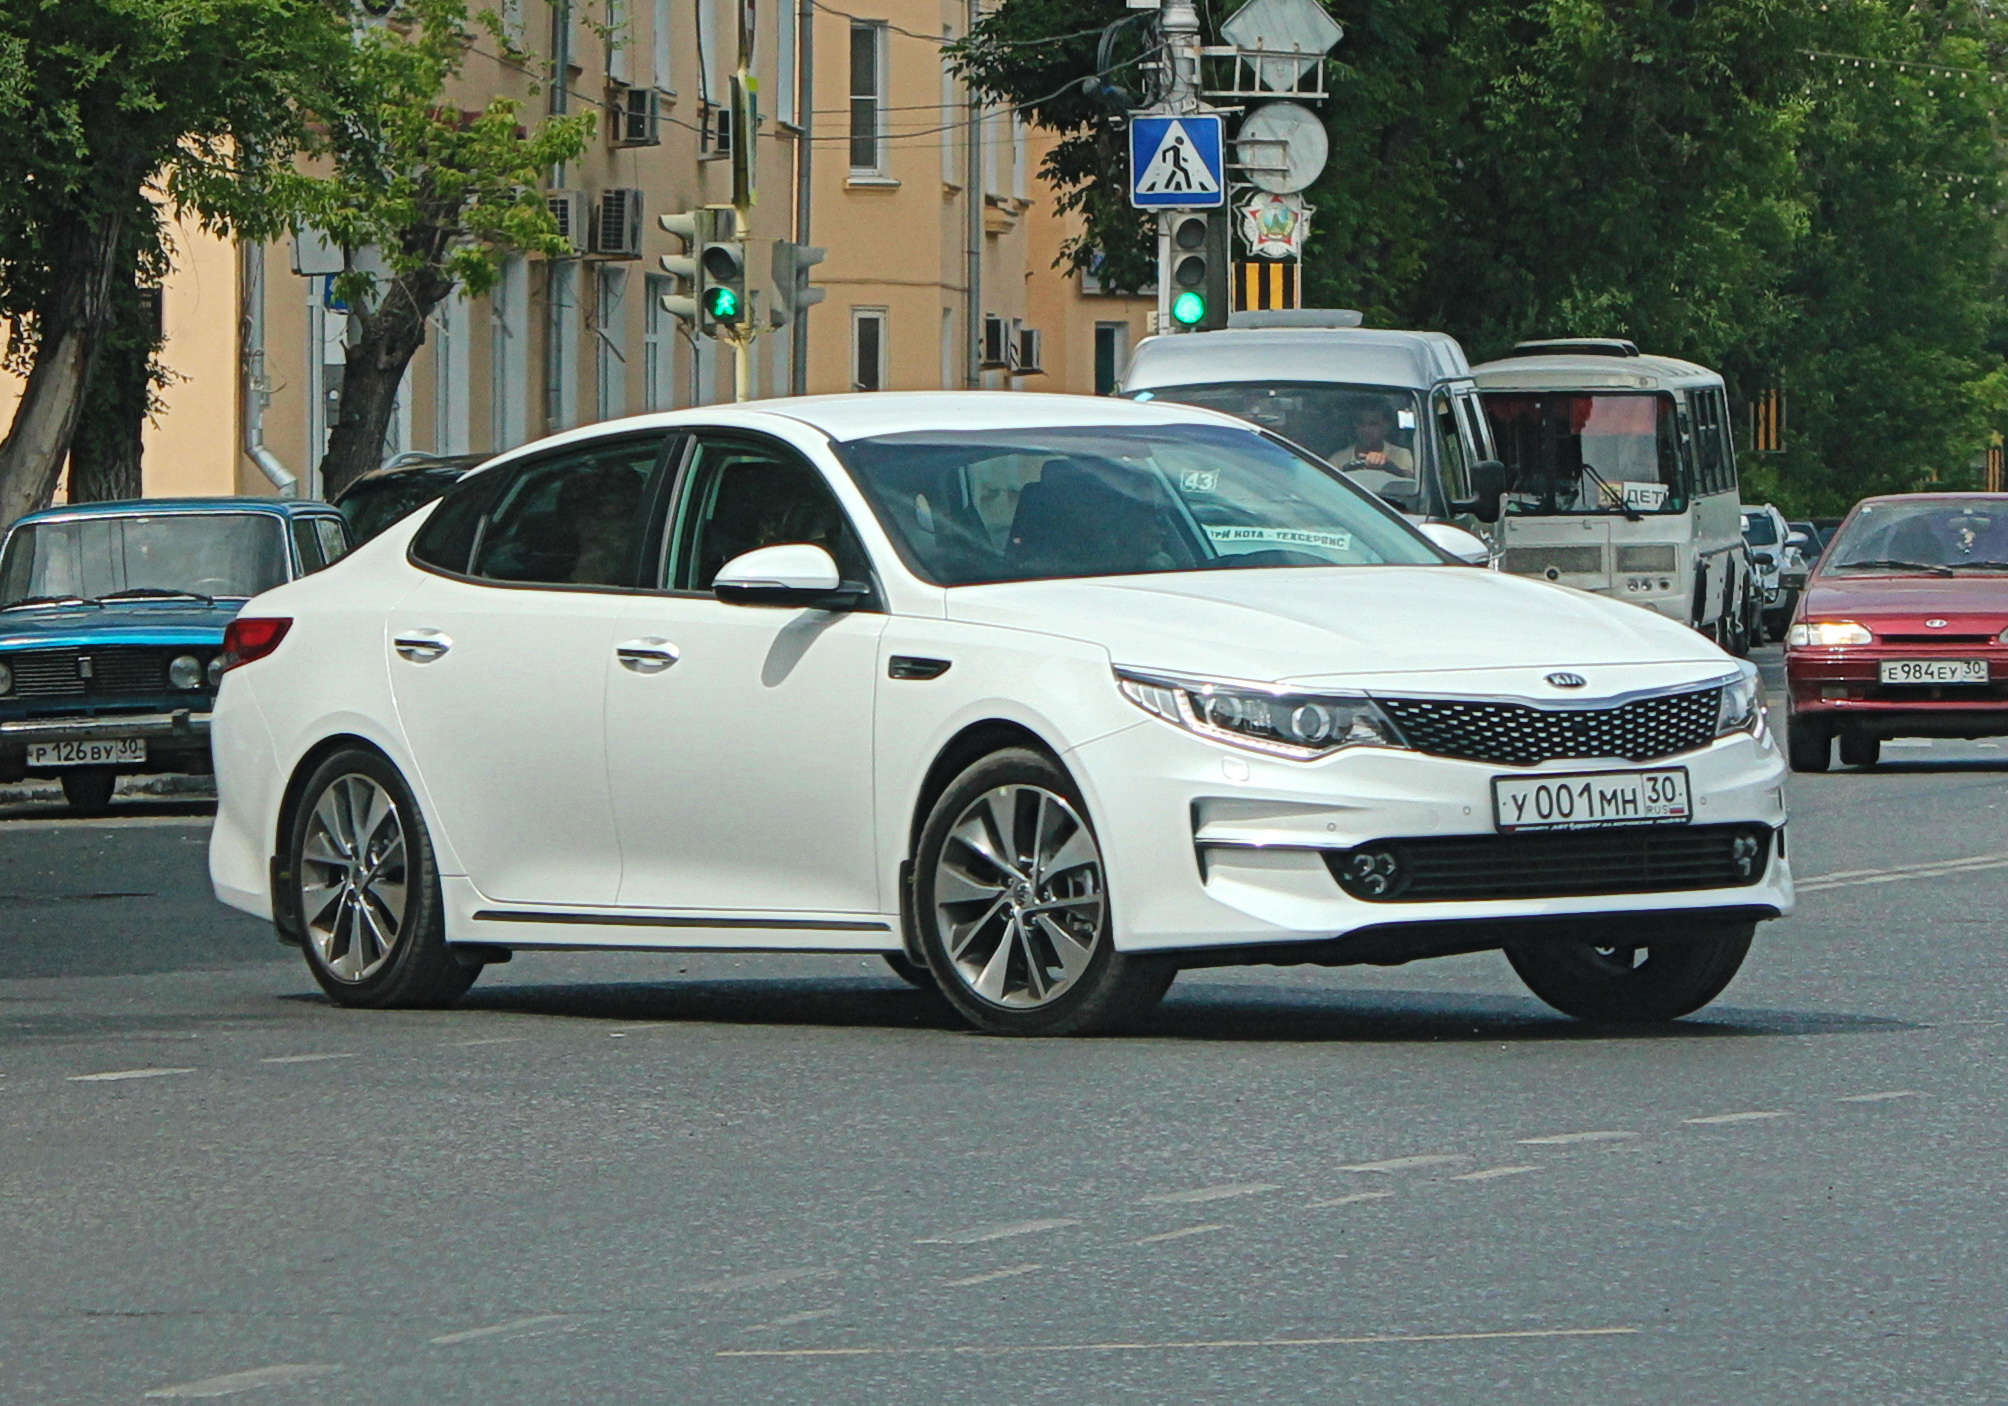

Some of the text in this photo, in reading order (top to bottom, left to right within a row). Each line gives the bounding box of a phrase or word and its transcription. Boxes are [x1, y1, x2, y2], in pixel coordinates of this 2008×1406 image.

[1184, 472, 1214, 490] 43
[1276, 532, 1345, 547] ТЕХСЕРВИС
[1548, 673, 1585, 687] KIA
[1511, 776, 1676, 821] У001МН 30
[1646, 804, 1668, 816] RUS
